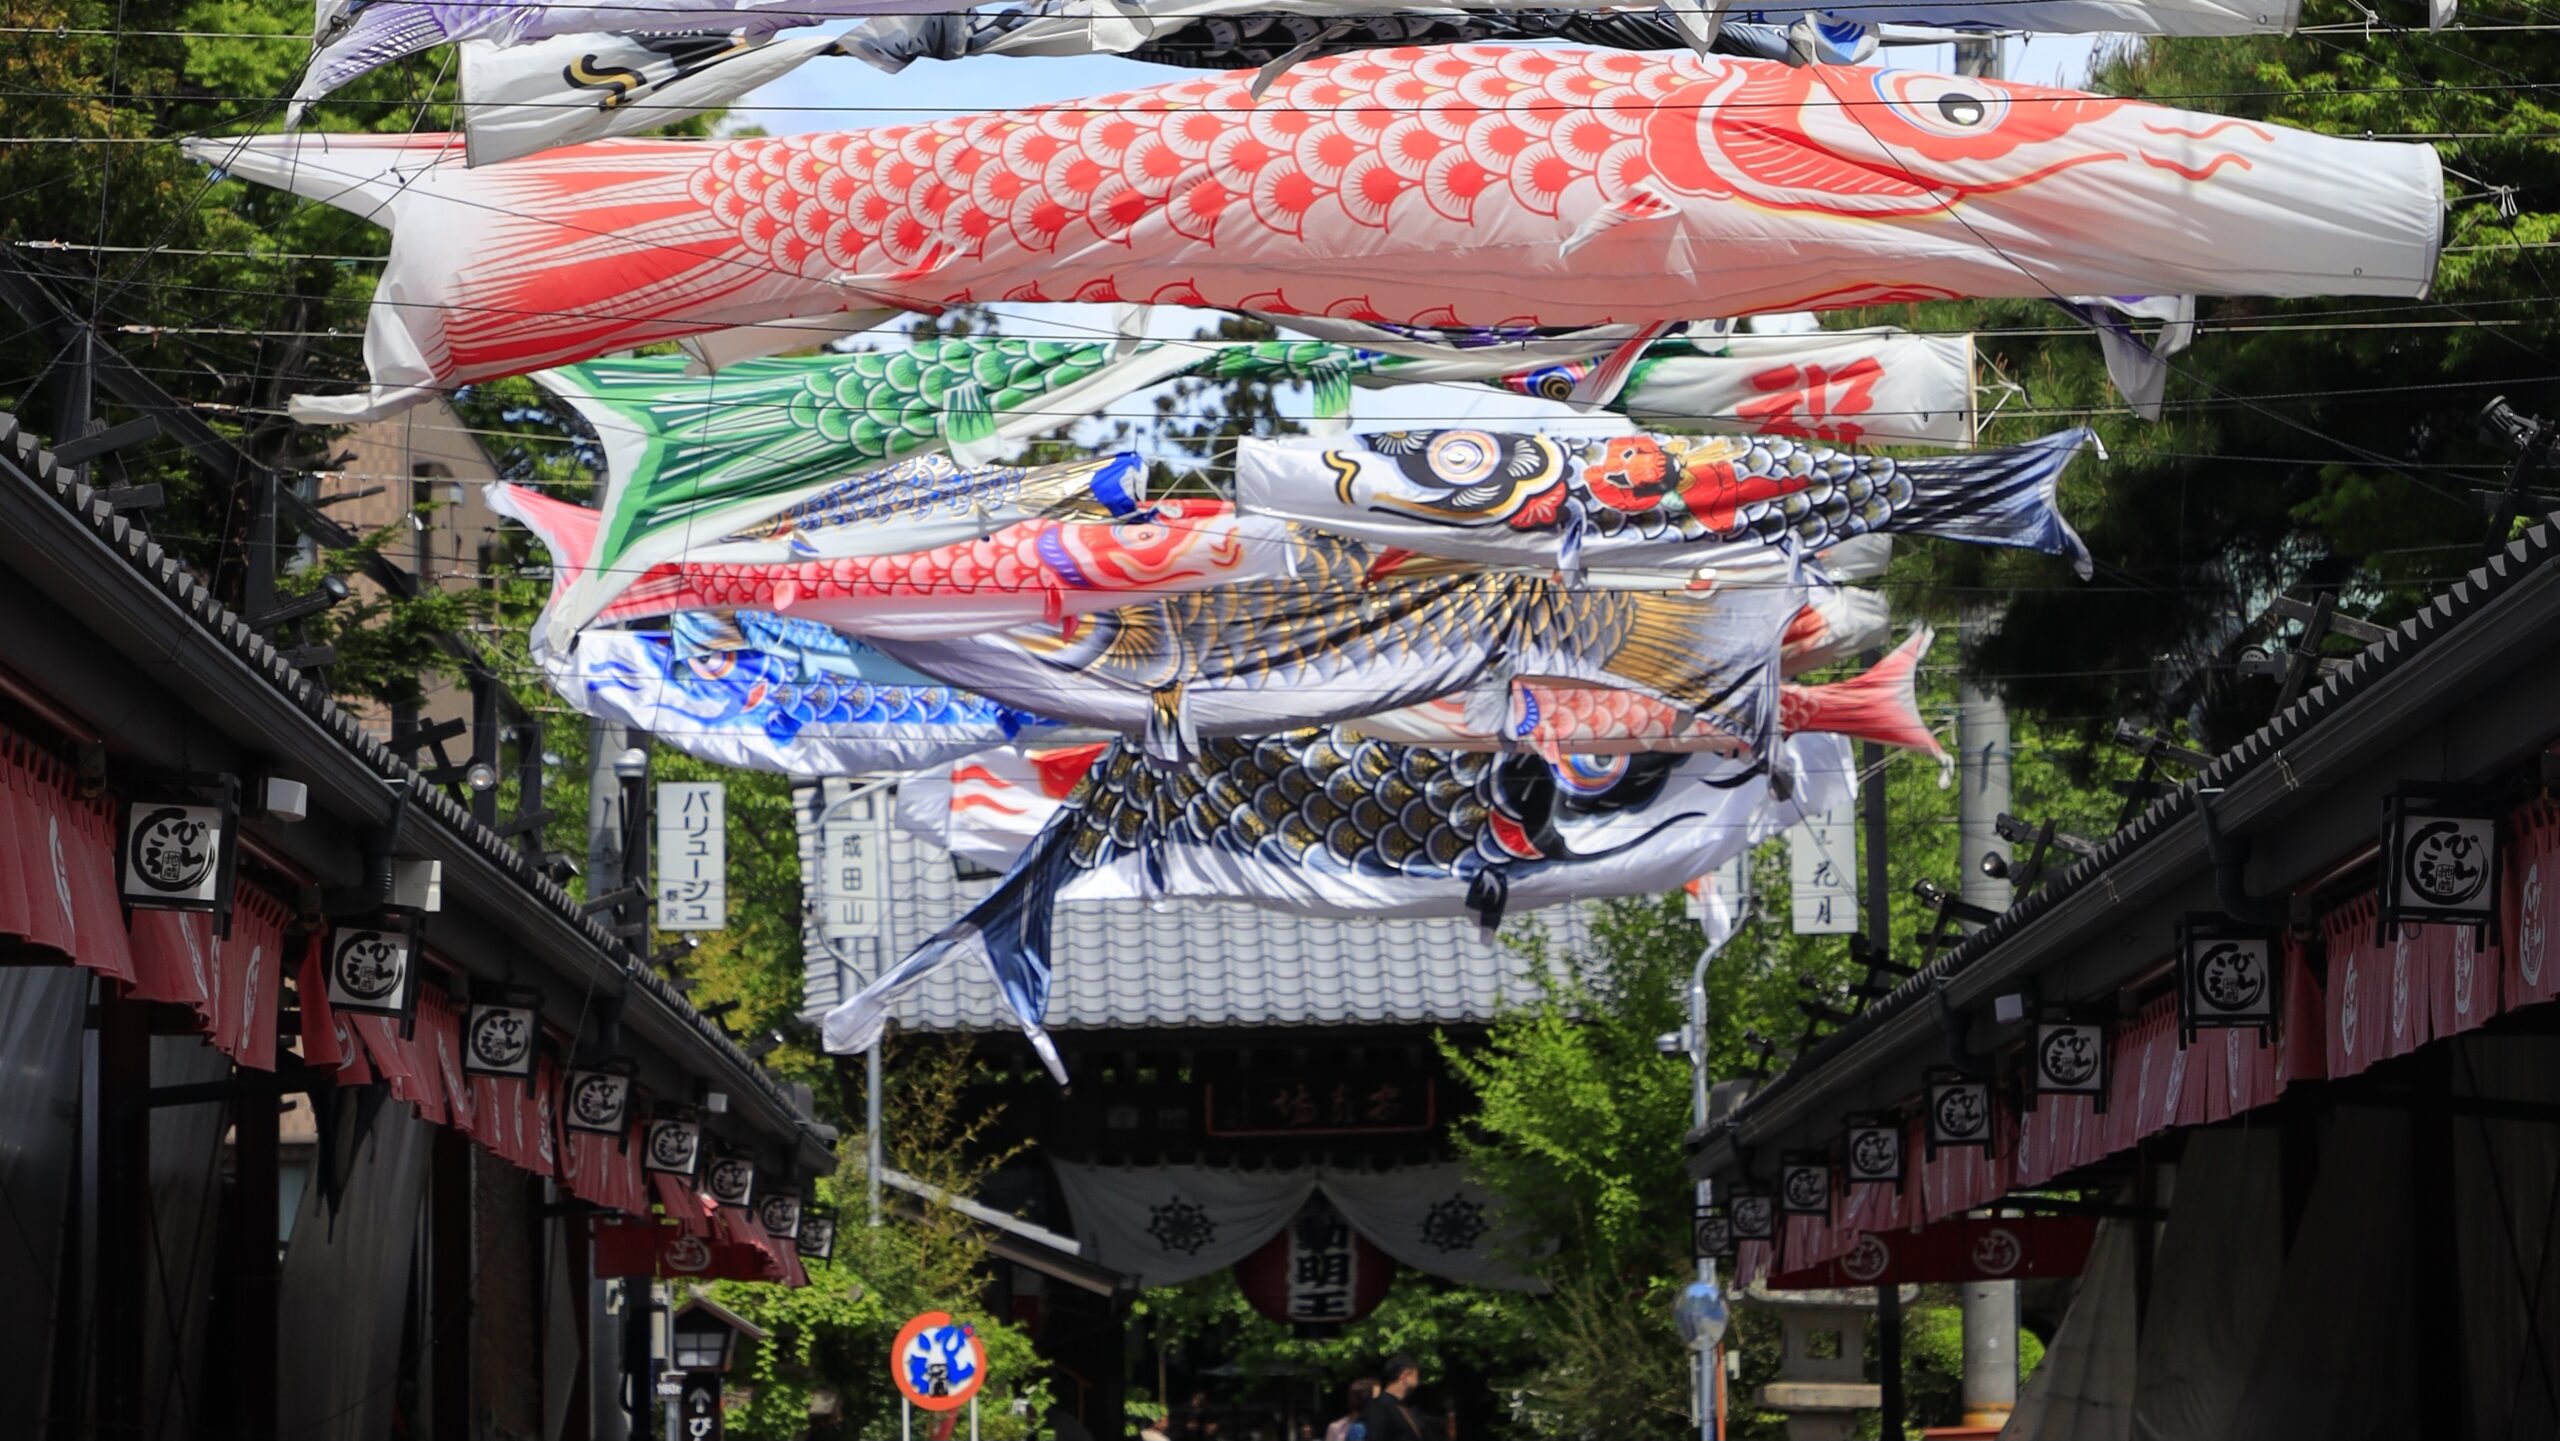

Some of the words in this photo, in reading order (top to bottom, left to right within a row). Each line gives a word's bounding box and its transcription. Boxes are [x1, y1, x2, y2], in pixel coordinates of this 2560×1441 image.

[683, 789, 710, 921] バリュージュ
[842, 832, 863, 925] 成田山
